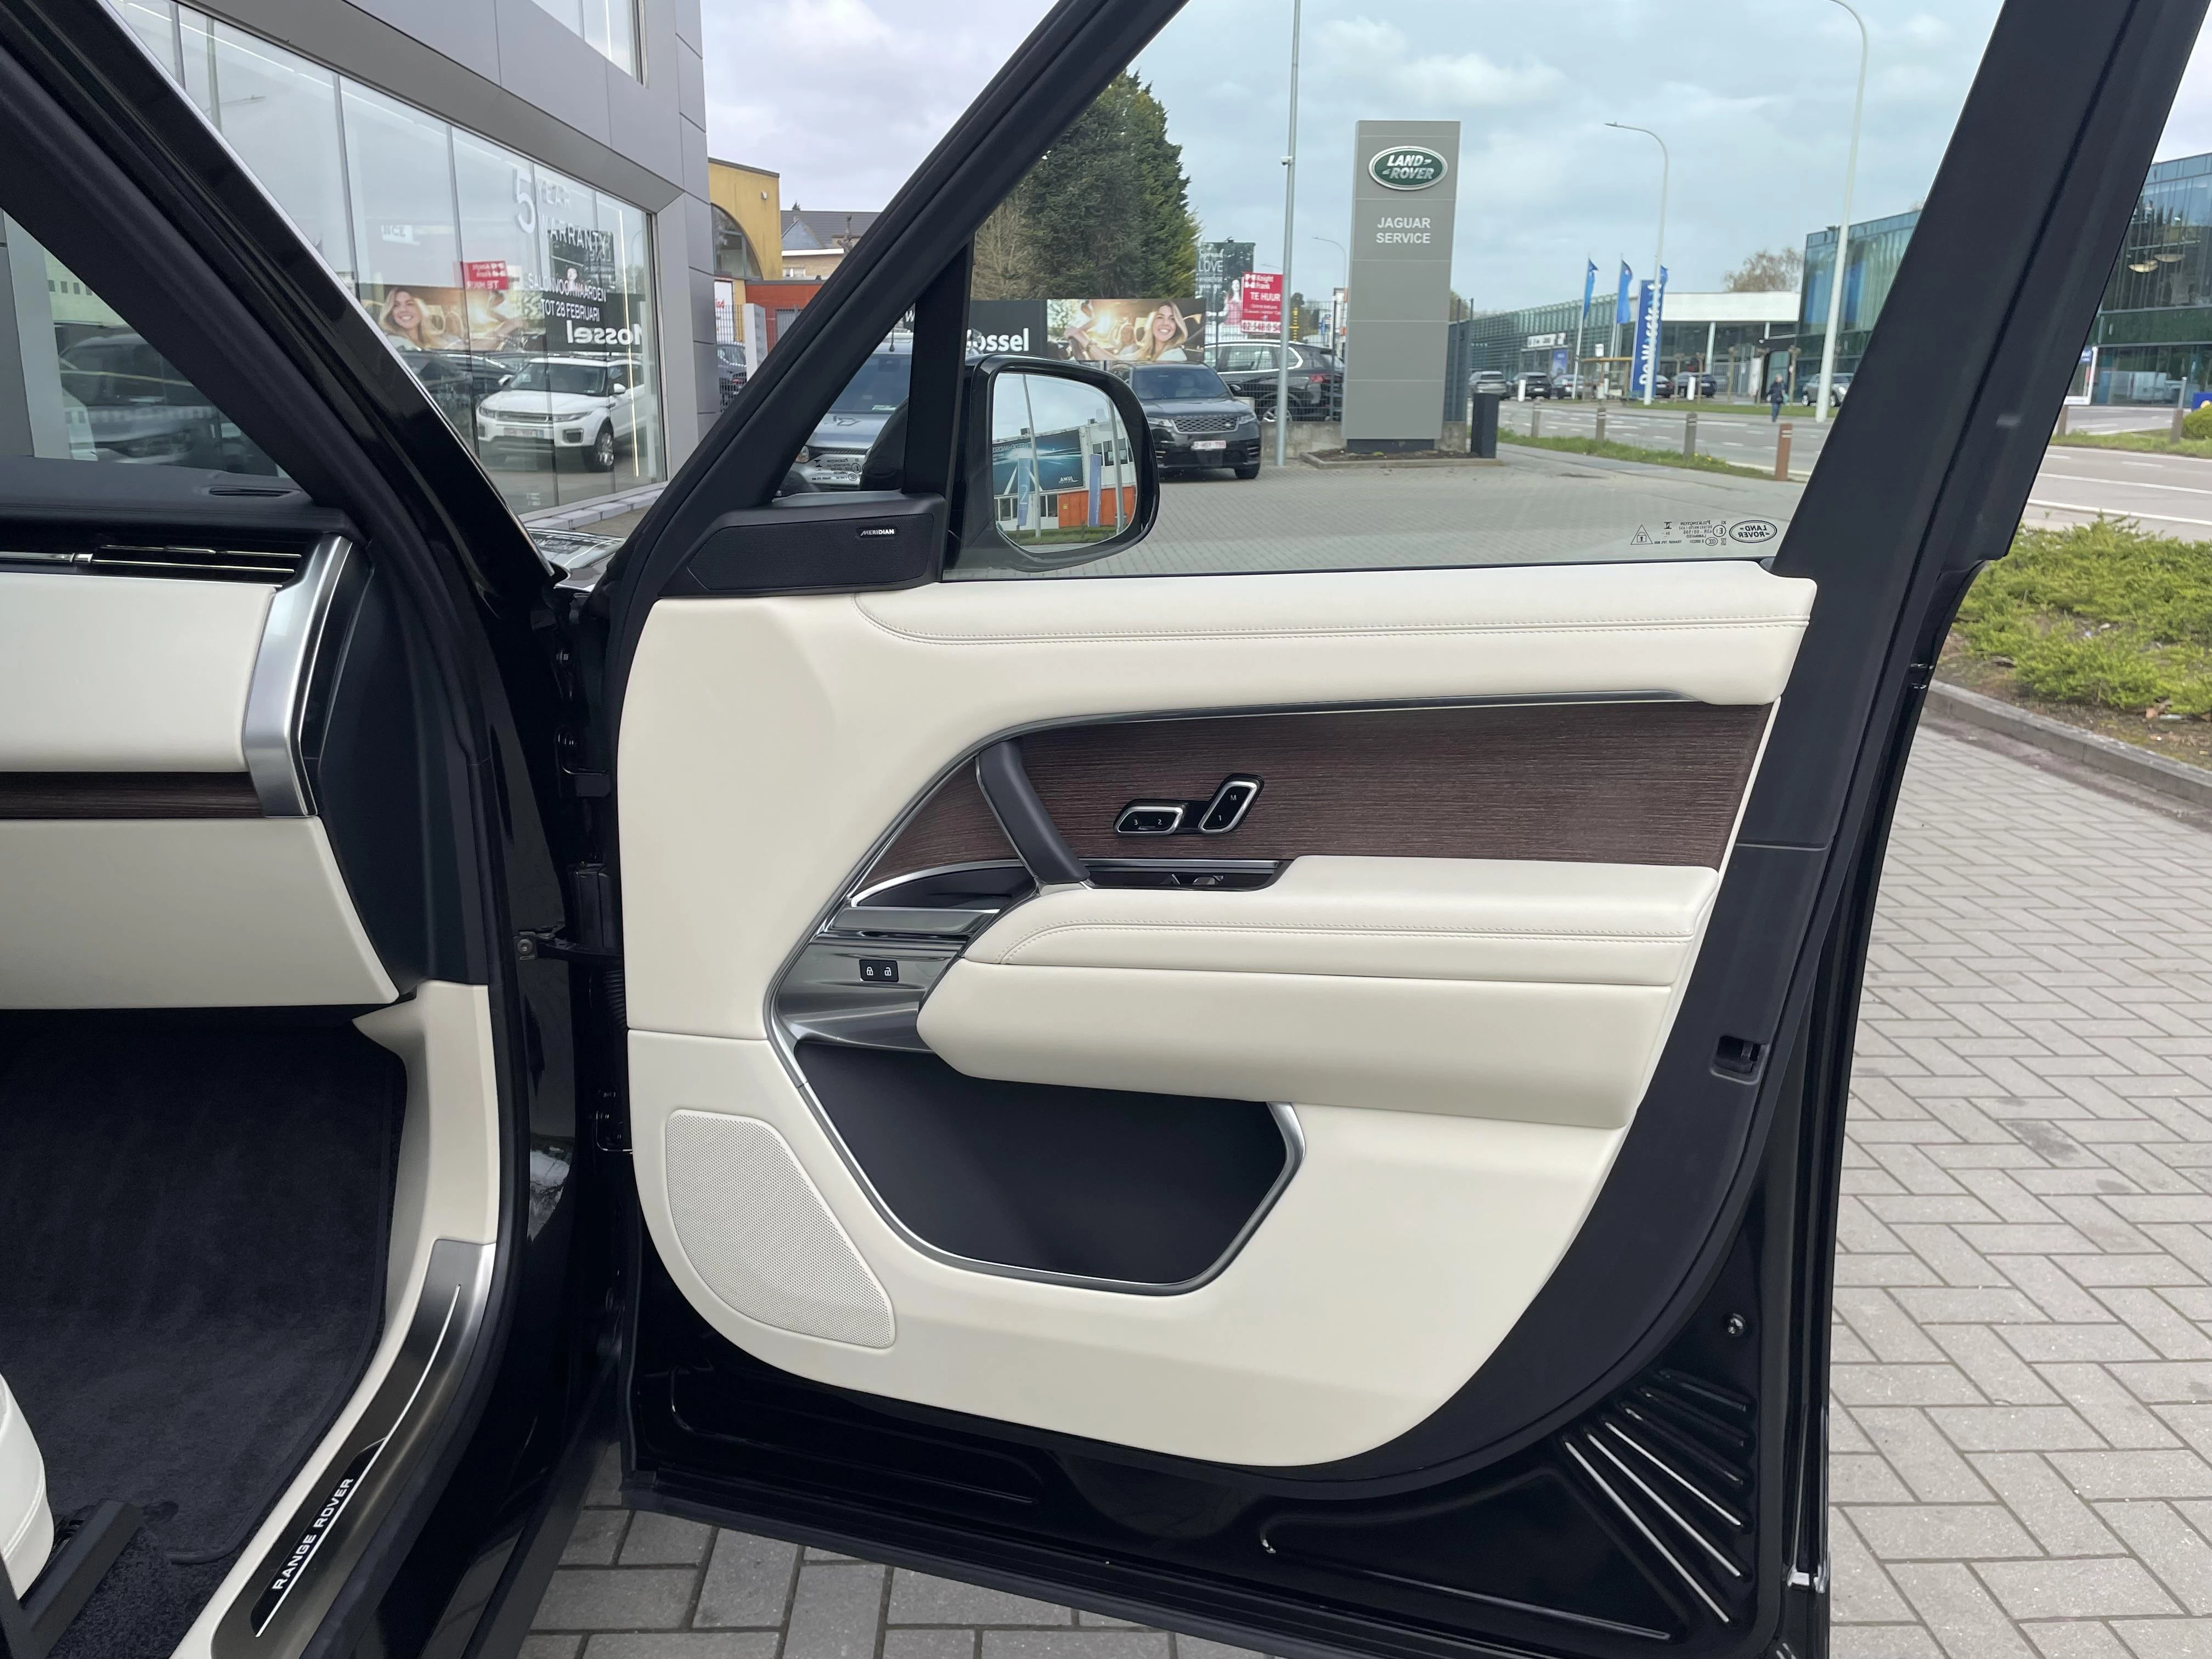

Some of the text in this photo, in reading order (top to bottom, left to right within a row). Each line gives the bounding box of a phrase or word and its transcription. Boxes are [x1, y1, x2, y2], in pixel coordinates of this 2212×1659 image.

[1387, 155, 1425, 167] LAND
[1389, 167, 1434, 179] ROVER
[516, 166, 536, 234] 5
[1376, 217, 1431, 229] JAGUAR
[1375, 233, 1431, 244] SERVICE
[1198, 260, 1223, 272] LOVE
[1250, 292, 1281, 301] TE HUUR
[540, 298, 600, 322] TOT 28 FEBRUARI
[860, 528, 895, 537] MERIDIAN
[272, 1478, 354, 1590] RANGE ROVER
